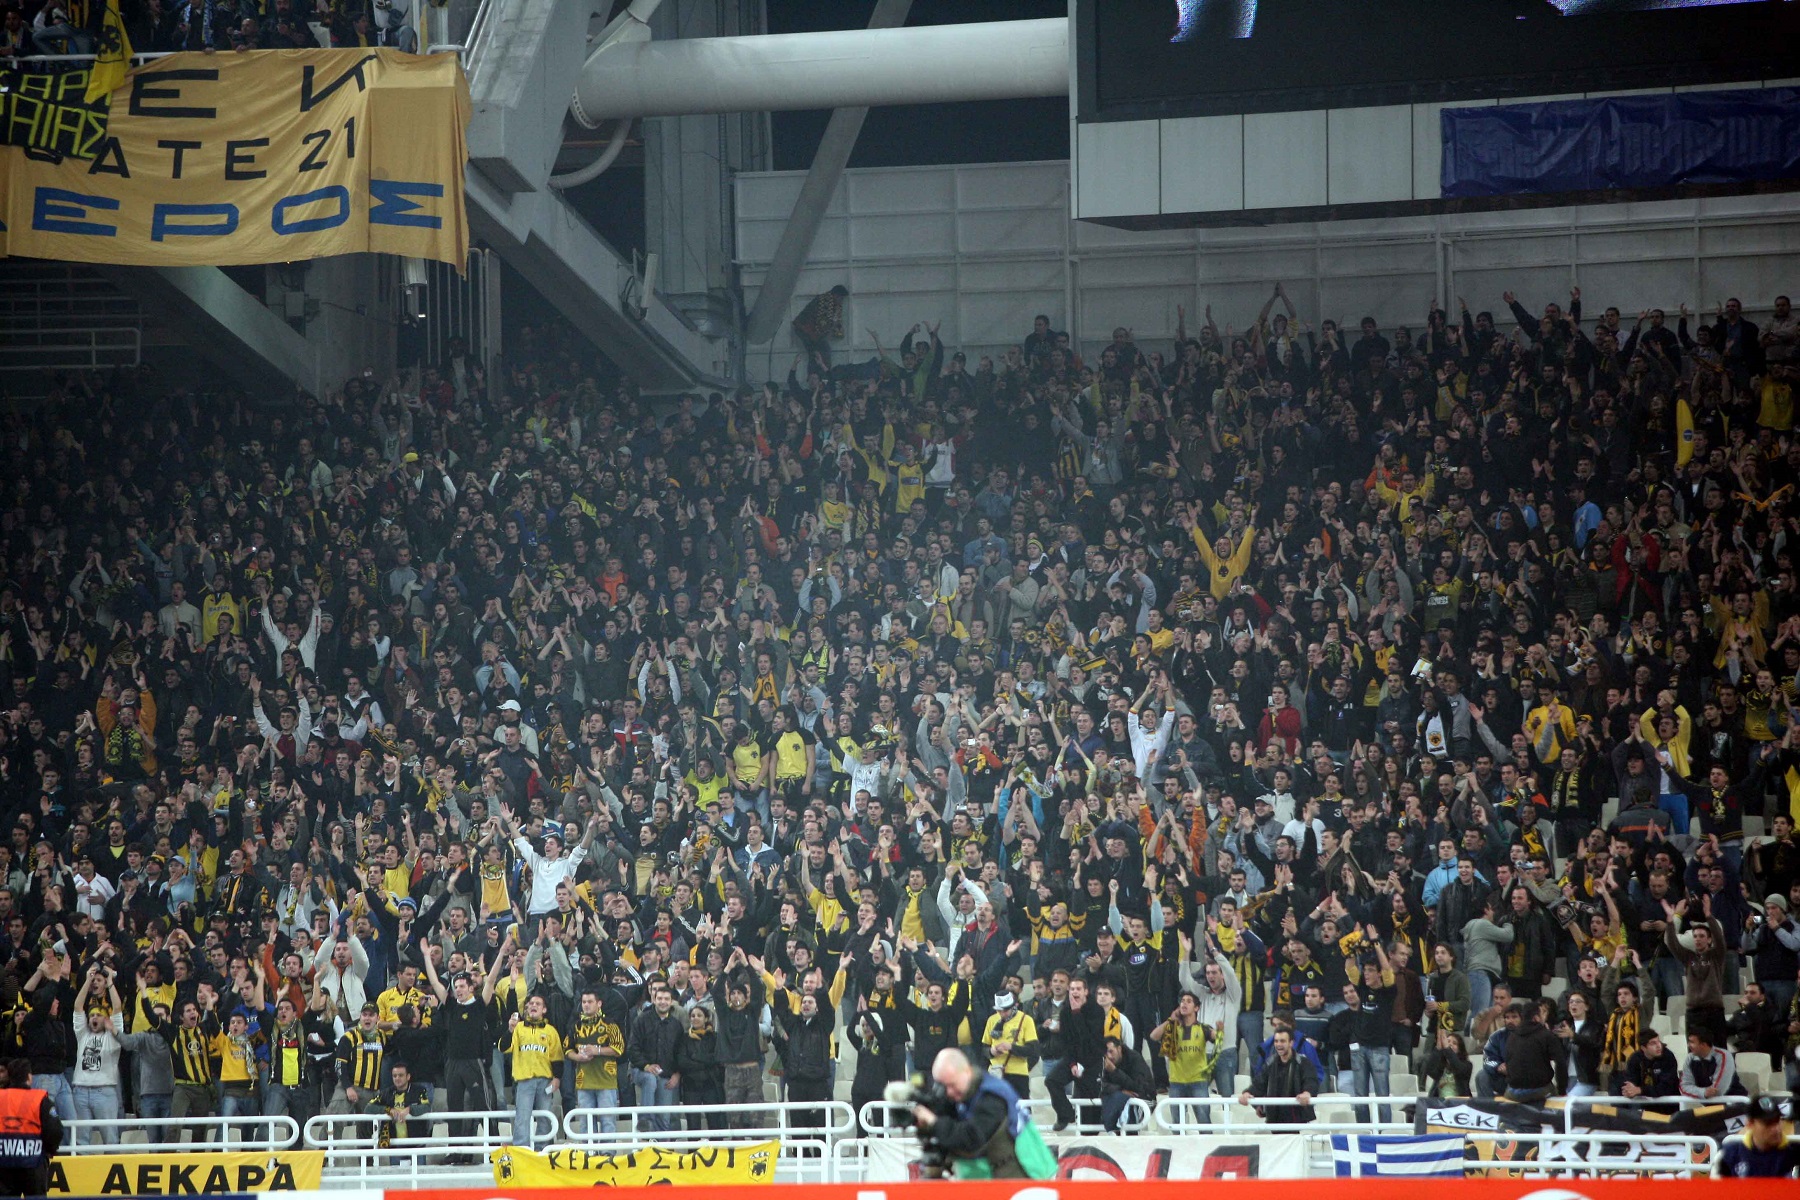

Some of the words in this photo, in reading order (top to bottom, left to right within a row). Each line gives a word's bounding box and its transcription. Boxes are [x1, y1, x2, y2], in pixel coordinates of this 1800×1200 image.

[24, 137, 270, 181] ATE
[299, 117, 355, 172] 21
[0, 179, 444, 242] ΕΡΟΣ
[1134, 954, 1145, 963] TIM
[1176, 1045, 1201, 1053] ARFIN
